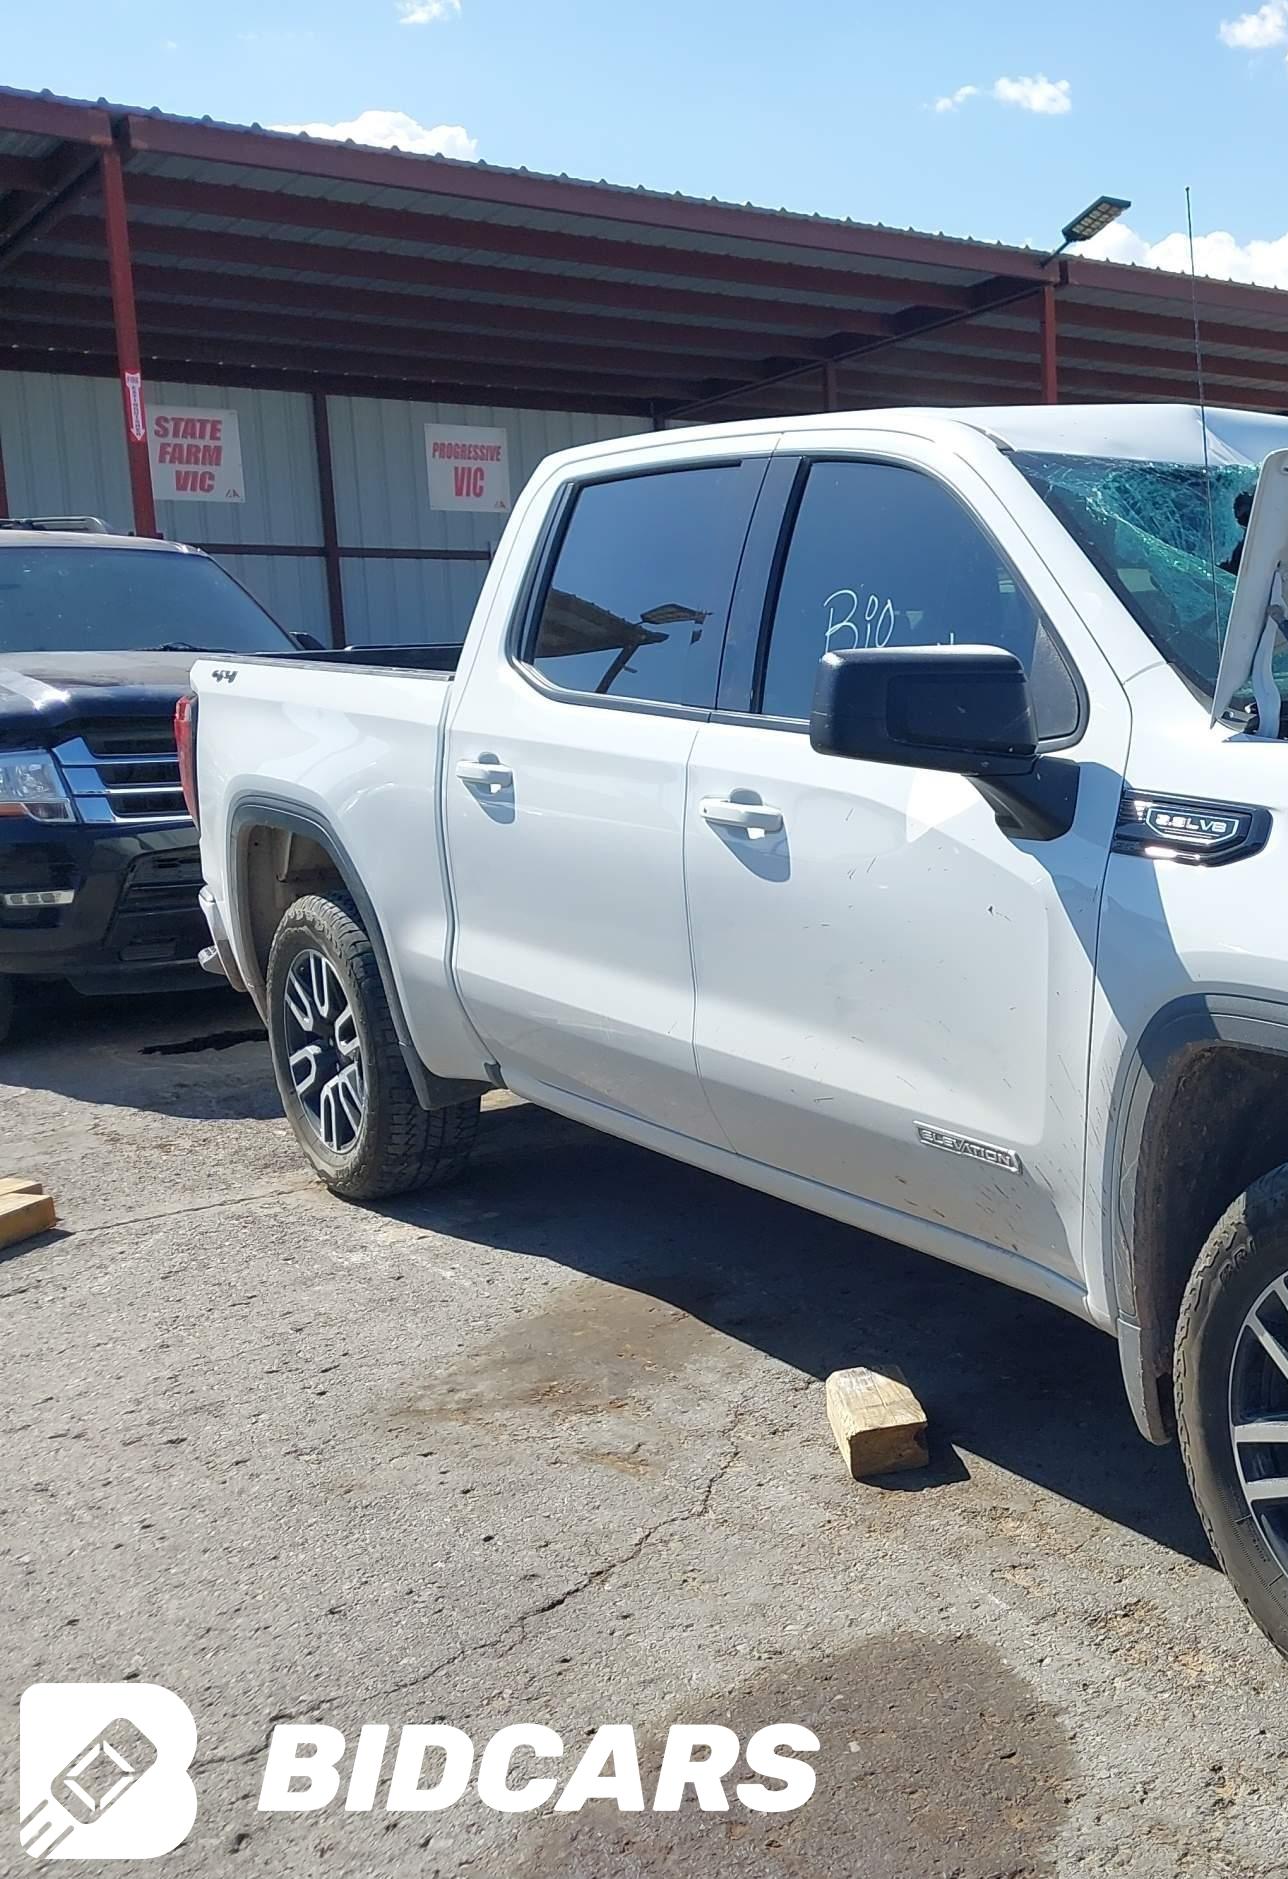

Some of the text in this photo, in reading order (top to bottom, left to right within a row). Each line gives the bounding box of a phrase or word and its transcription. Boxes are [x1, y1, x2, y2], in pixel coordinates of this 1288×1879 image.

[153, 415, 223, 441] STATE
[158, 442, 223, 467] FARM
[431, 441, 502, 462] PROGRESSIVE
[175, 469, 216, 493] VIC
[453, 466, 485, 497] VIC
[921, 1129, 1011, 1166] ELEVATION
